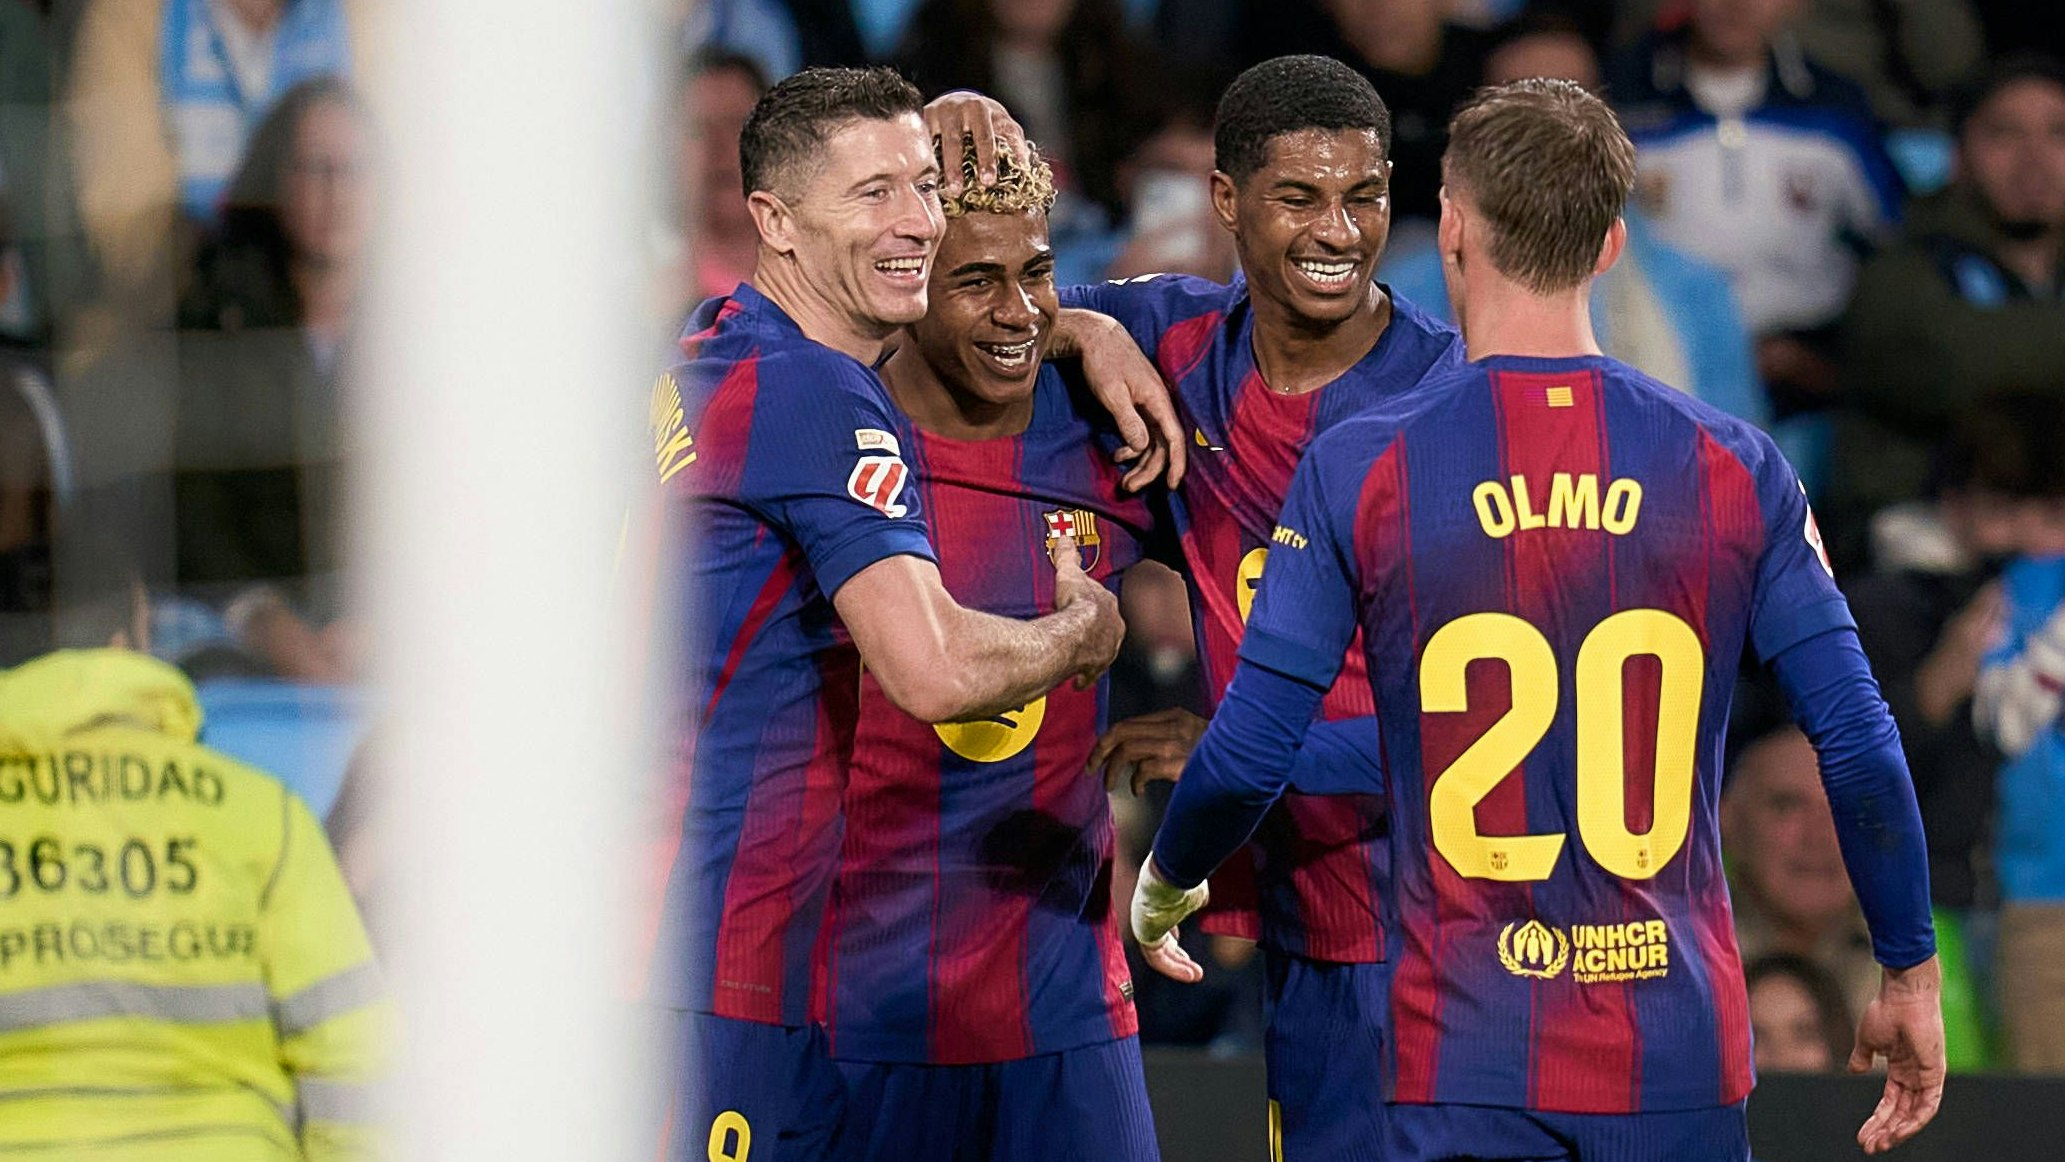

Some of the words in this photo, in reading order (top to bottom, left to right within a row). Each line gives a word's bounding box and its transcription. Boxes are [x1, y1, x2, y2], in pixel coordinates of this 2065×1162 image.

[1473, 472, 1642, 538] OLMO
[1420, 608, 1704, 882] 20
[1572, 920, 1667, 949] UNHCR
[1573, 944, 1668, 972] ACNUR
[1636, 968, 1668, 979] Agency
